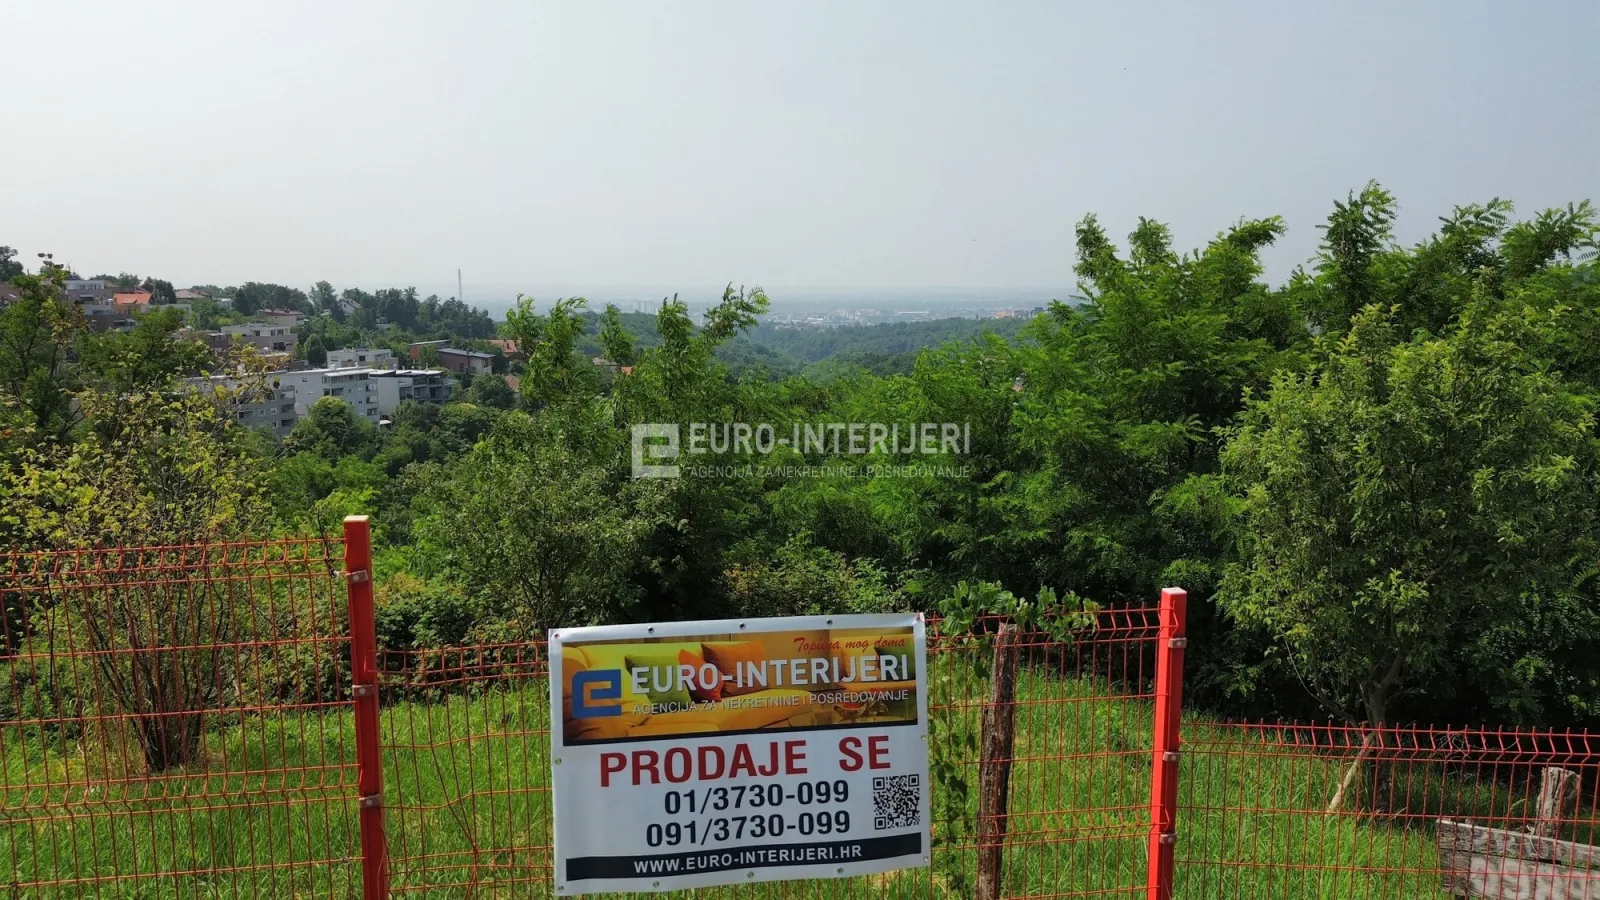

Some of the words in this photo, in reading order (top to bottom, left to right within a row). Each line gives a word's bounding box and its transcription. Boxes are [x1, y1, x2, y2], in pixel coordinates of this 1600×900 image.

[844, 638, 871, 652] mog
[874, 637, 906, 648] doma
[631, 654, 909, 695] EURO-INTERIJERI
[633, 701, 698, 715] AGENCIJA
[701, 700, 718, 712] ZA
[721, 696, 801, 711] NEKRETNINE
[809, 689, 910, 705] POSREDOVANJE
[600, 740, 808, 787] PRODAJE
[838, 735, 891, 772] SE
[664, 780, 850, 816] 01/3730-099
[646, 810, 851, 847] 091/3730-099
[633, 844, 862, 874] WWW.EURO-INTERIJERI.HR
